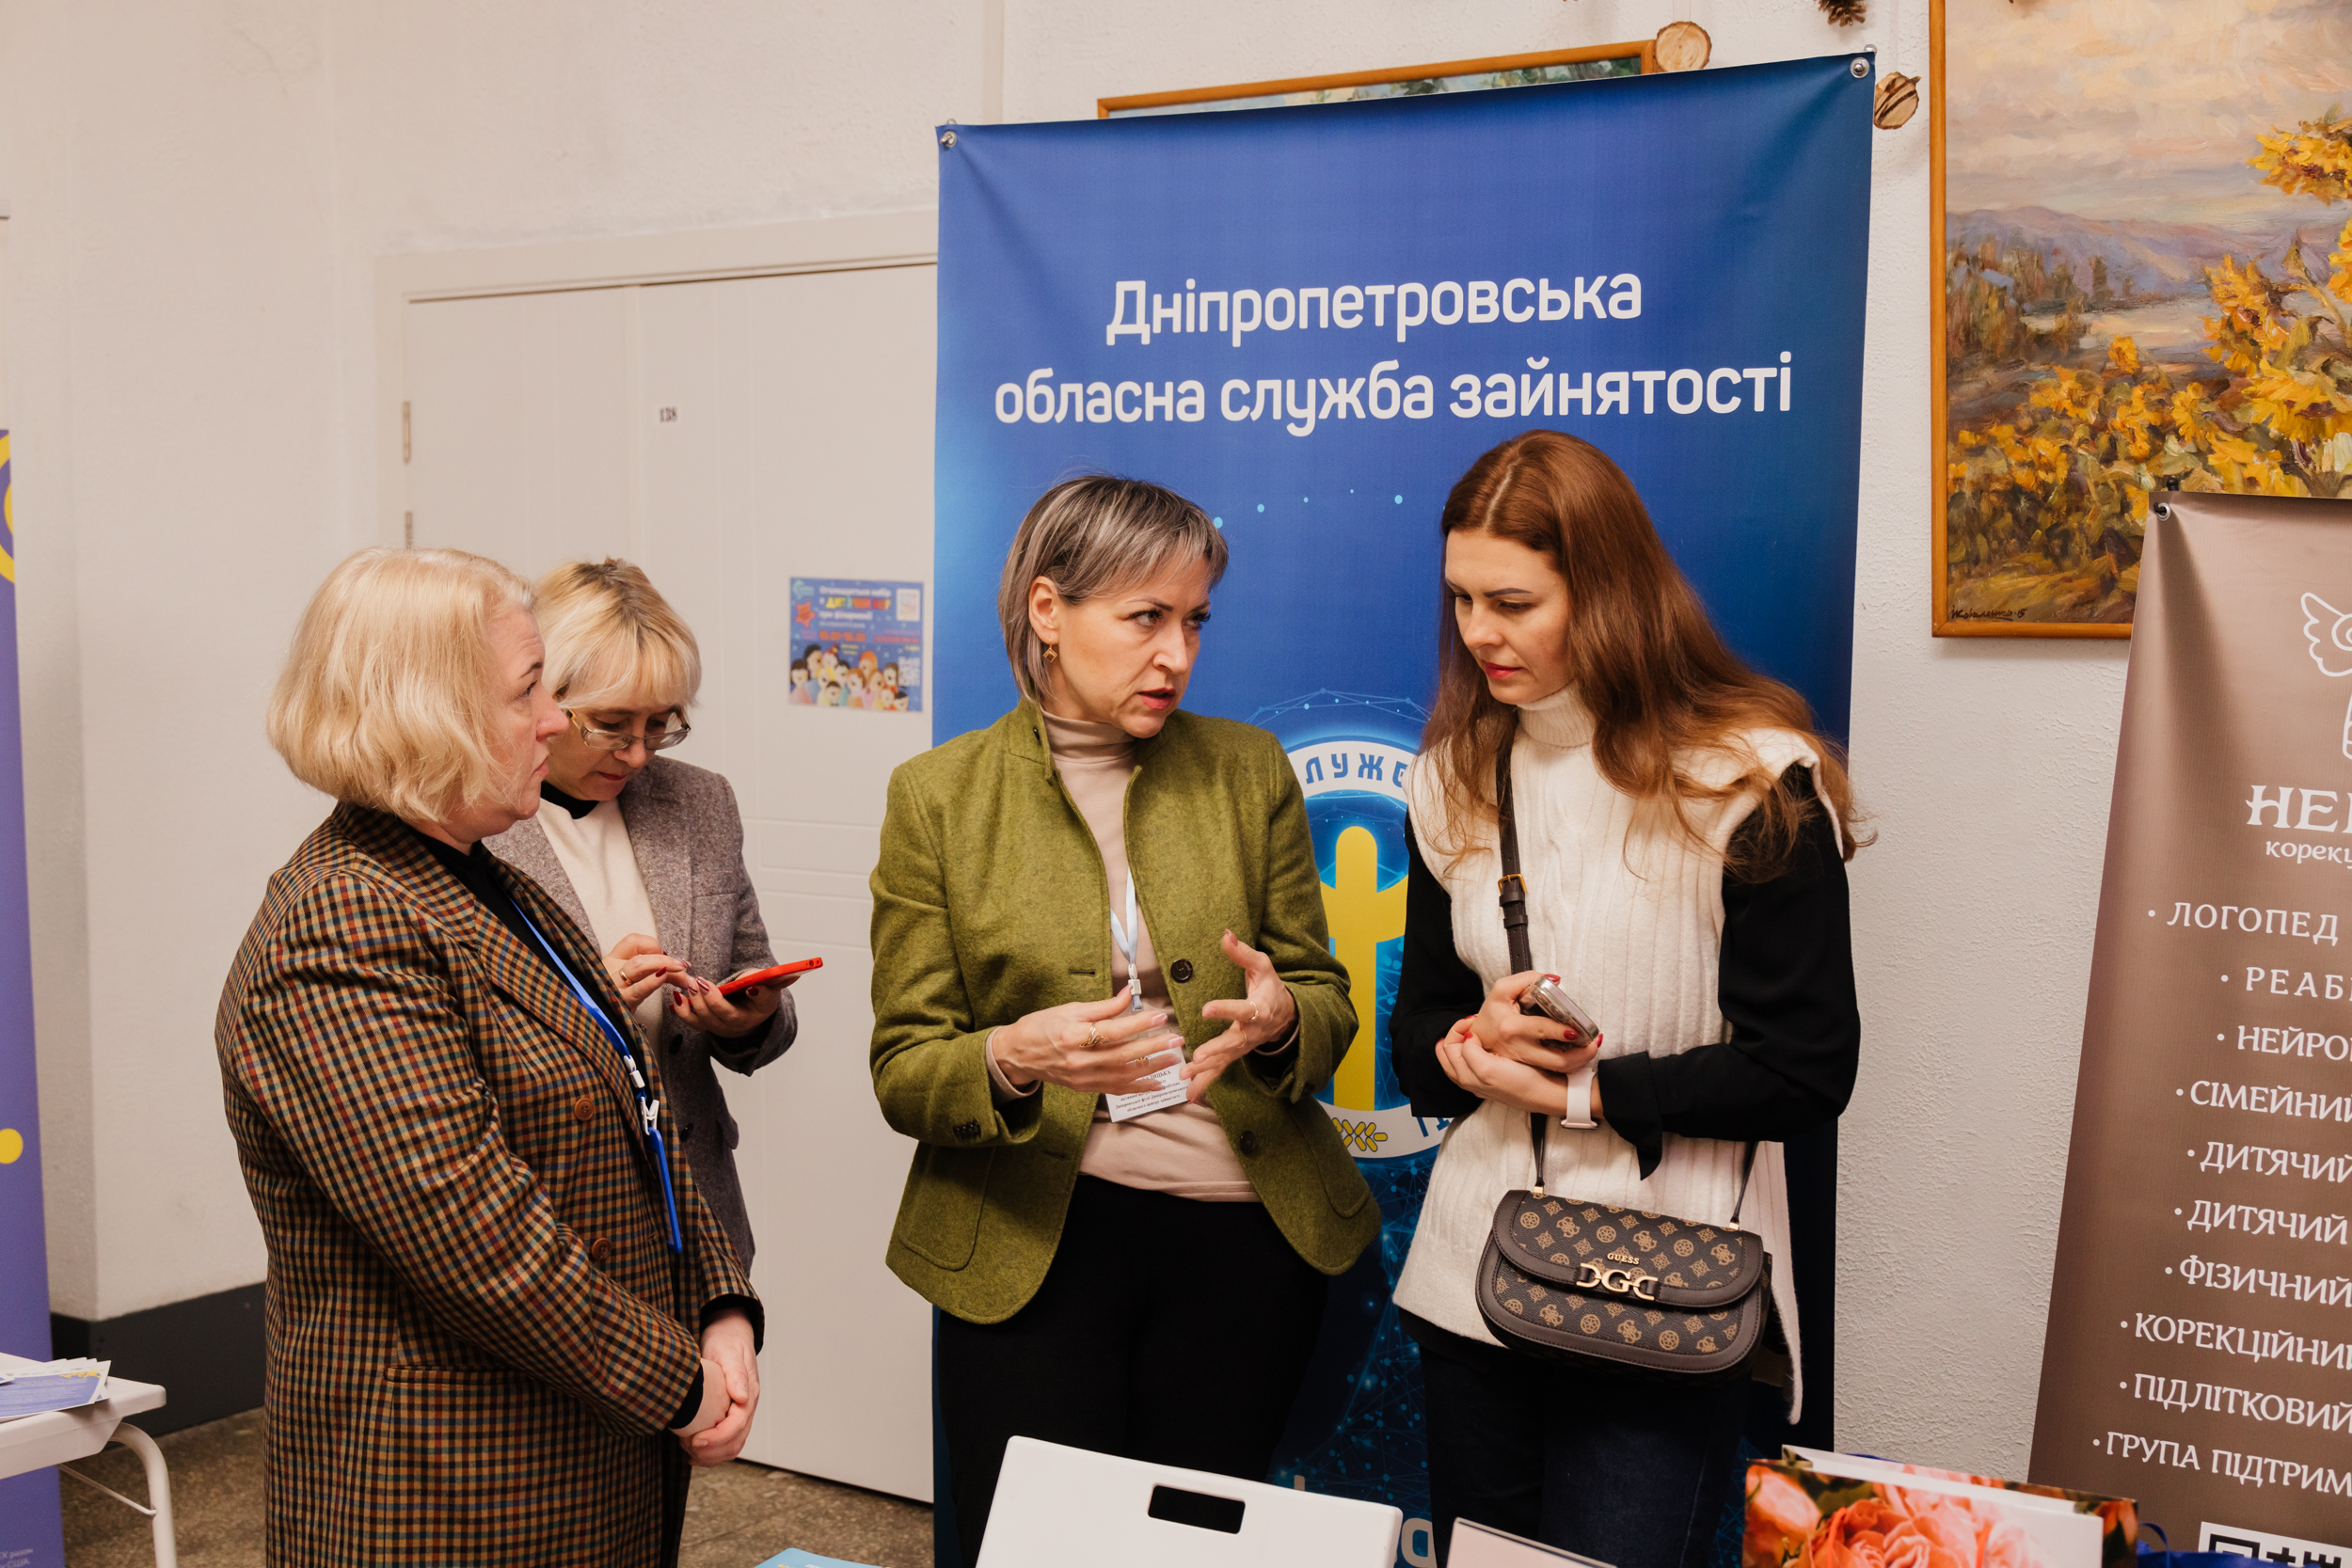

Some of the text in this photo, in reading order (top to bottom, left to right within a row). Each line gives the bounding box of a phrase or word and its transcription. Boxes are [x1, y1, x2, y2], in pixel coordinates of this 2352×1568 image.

[1105, 273, 1642, 348] Дніпропетровська
[994, 351, 1792, 437] обласна служба зайнятості
[1305, 752, 1408, 788] ЛУЖБ
[2166, 901, 2339, 947] ЛОГОПЕД
[2246, 966, 2352, 1002] РЕАБ
[2237, 1024, 2352, 1063] НЕЙРО
[2186, 1199, 2348, 1245] ДИТЯЧИЙ
[1607, 1252, 1640, 1265] GUESS
[2179, 1254, 2352, 1308] ФІЗИЧНИЙ
[2135, 1312, 2352, 1370] КОРЕКЦІЙНИ
[2134, 1373, 2352, 1434] ПІДЛІТКОВИЙ
[2106, 1431, 2352, 1497] ГРУПА ПІДТРИМ
